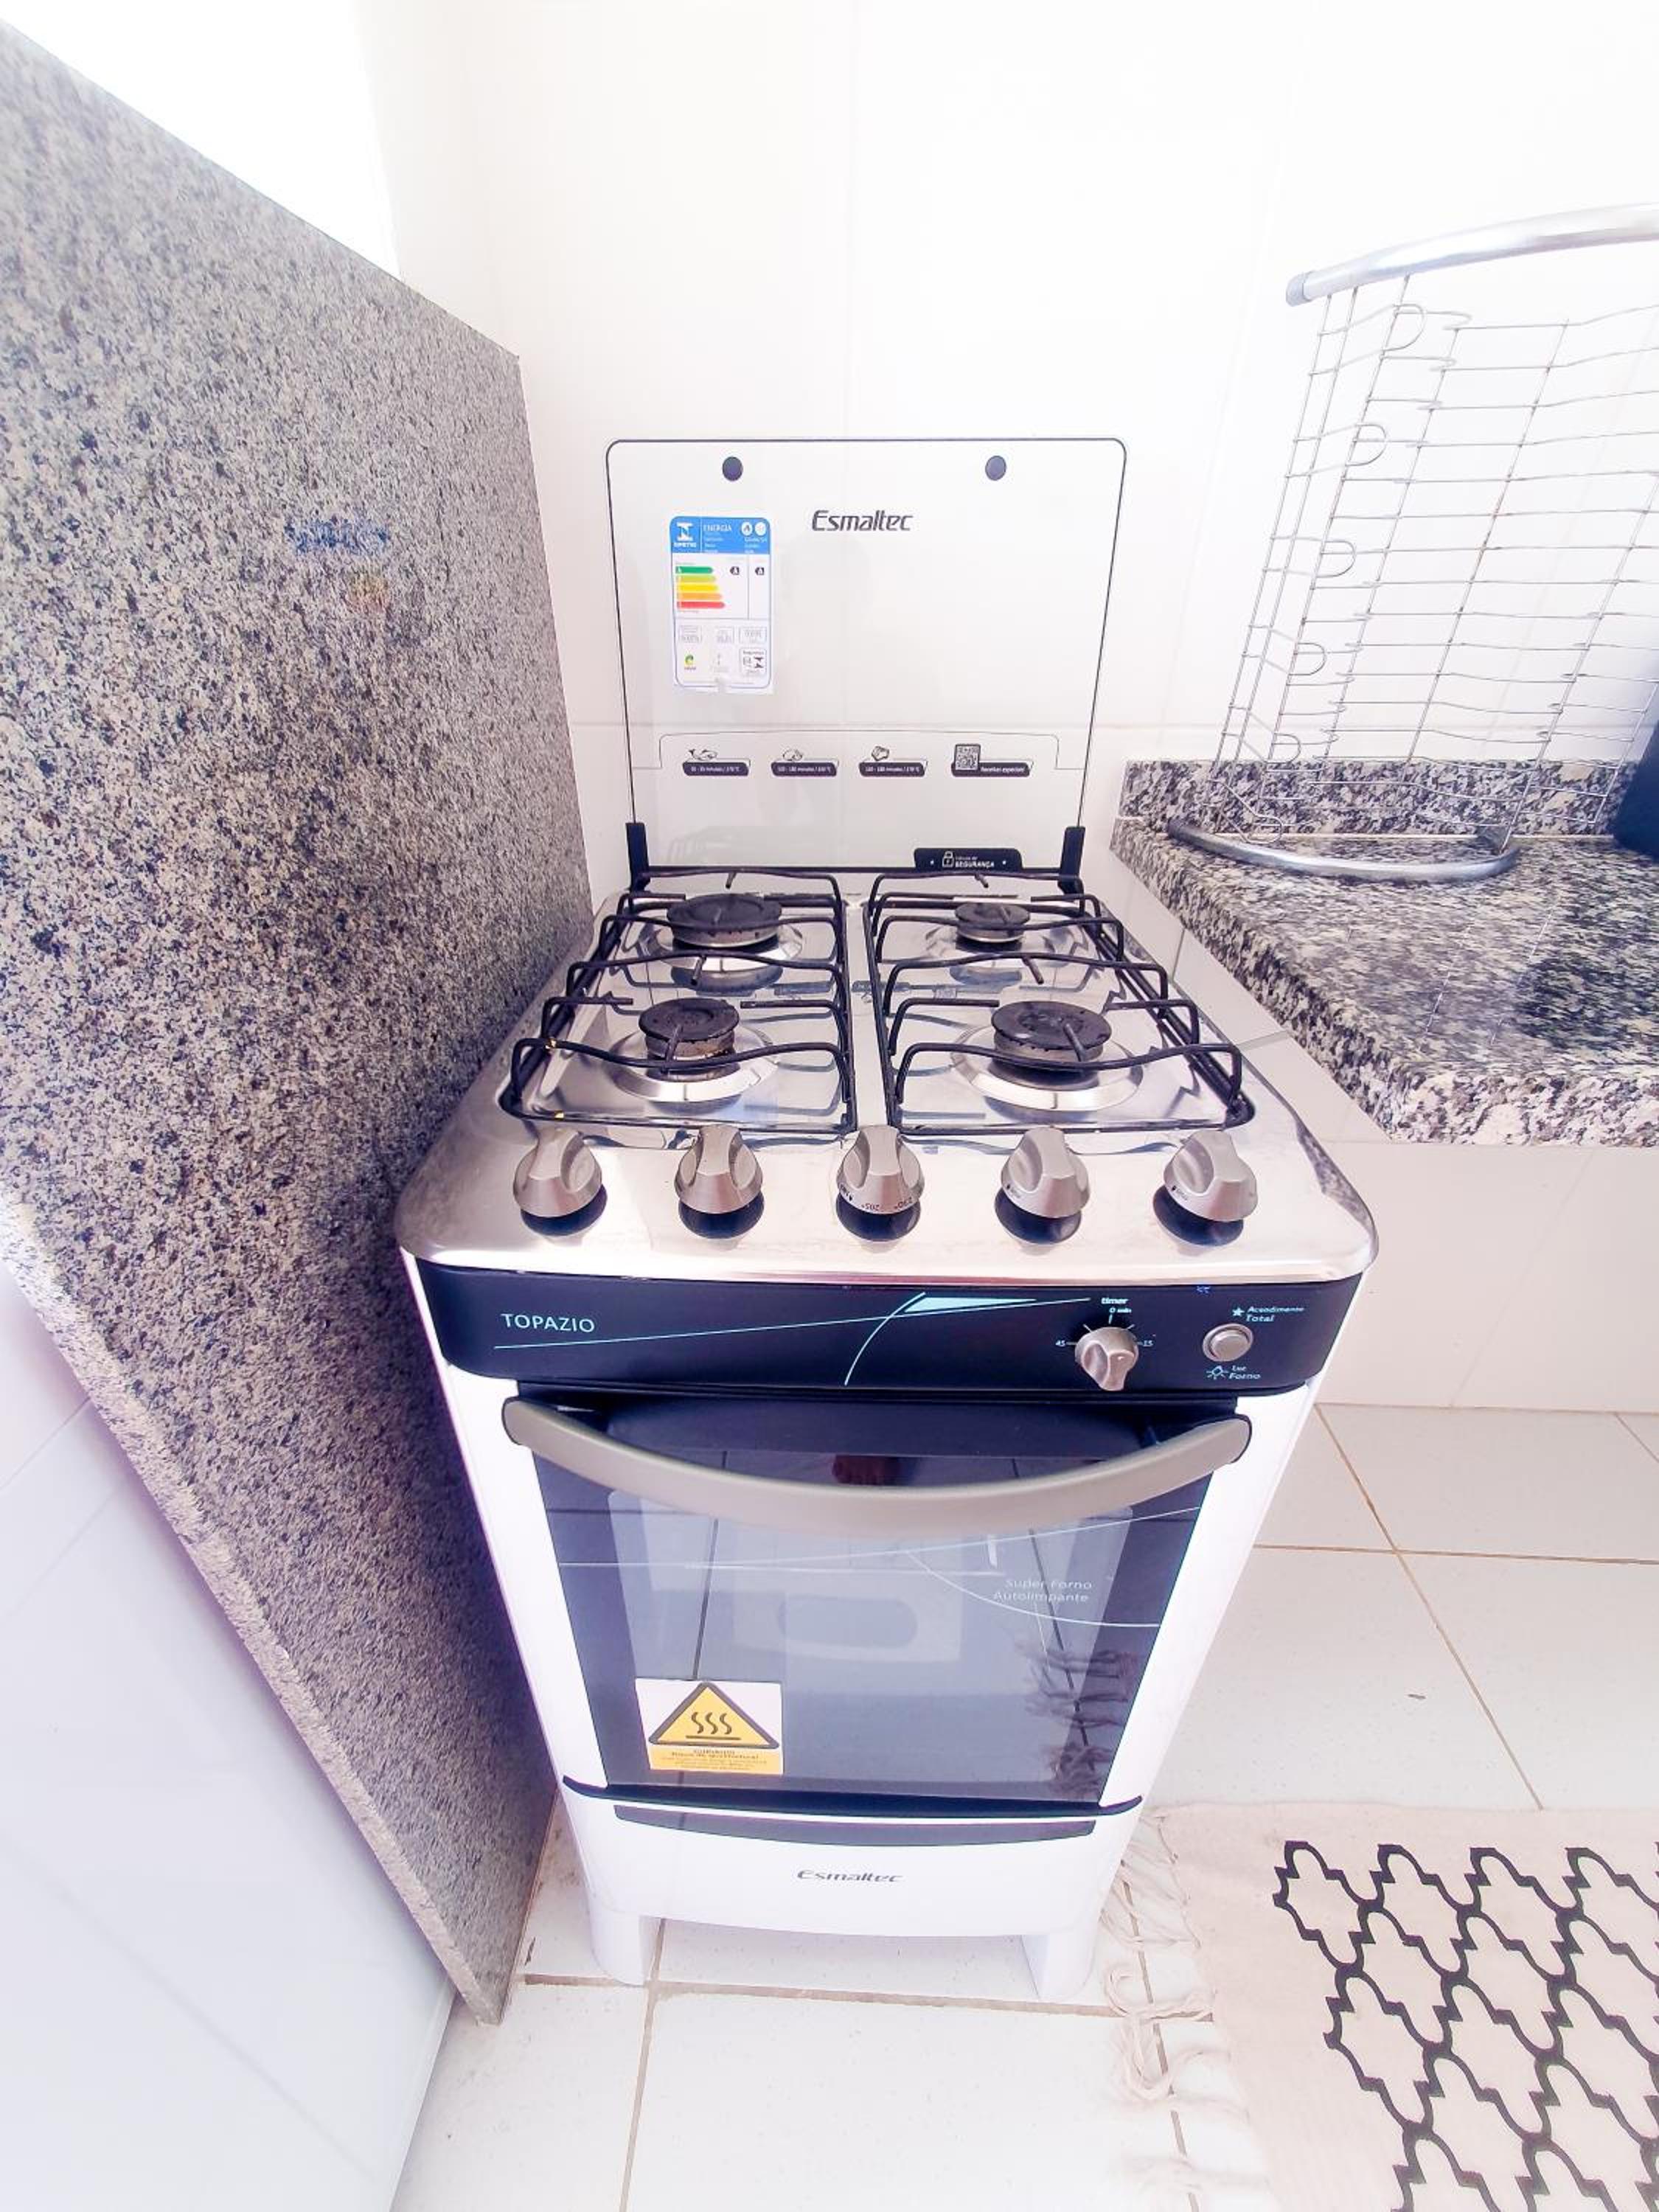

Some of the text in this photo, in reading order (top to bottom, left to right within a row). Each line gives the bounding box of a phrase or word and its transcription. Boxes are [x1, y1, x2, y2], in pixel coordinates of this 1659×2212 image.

[812, 509, 914, 532] Esmaltec
[501, 1313, 595, 1332] TOPAZIO
[1246, 1314, 1274, 1322] Total
[1228, 1372, 1261, 1380] Forno
[1006, 1579, 1093, 1590] Super Forno
[994, 1592, 1090, 1603] Autolimpante
[796, 1869, 904, 1882] Esmaltec
